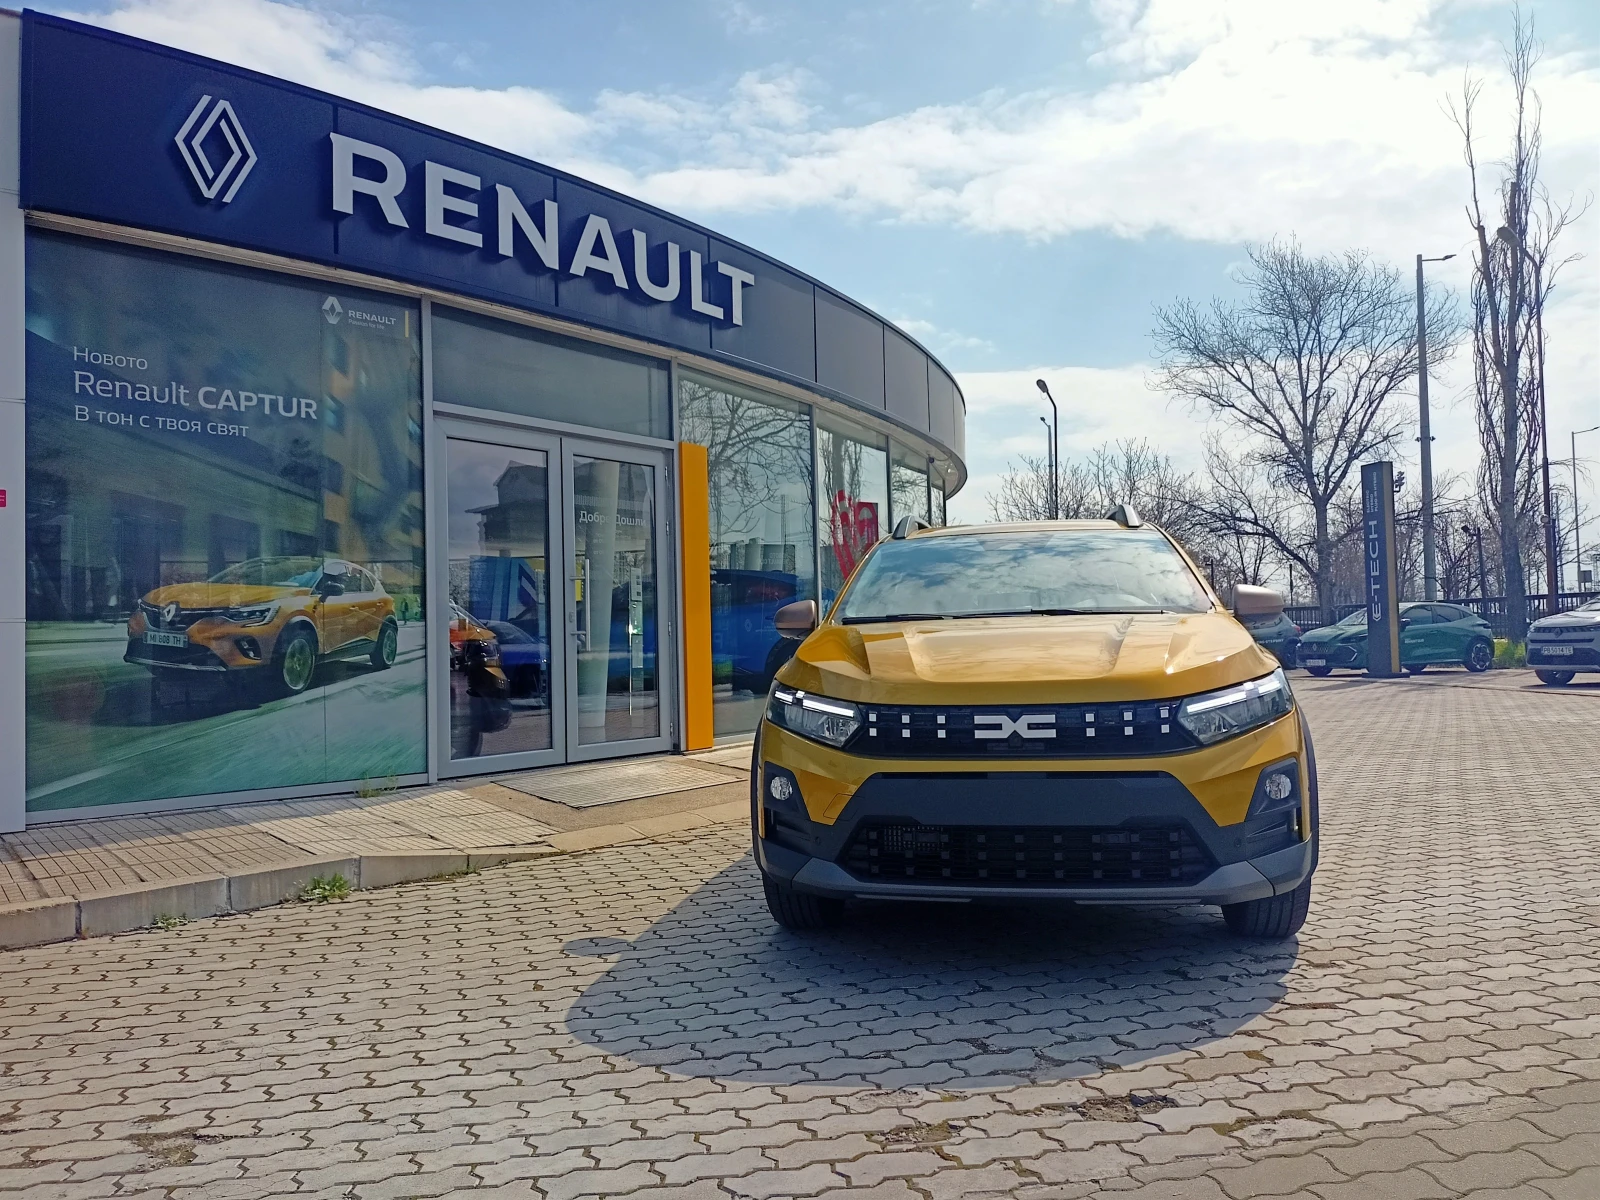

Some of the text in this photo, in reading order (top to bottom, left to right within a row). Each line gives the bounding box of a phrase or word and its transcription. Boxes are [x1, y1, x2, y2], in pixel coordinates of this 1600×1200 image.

[330, 132, 754, 326] RENAULT
[348, 310, 397, 325] RENAULT
[73, 346, 148, 370] Новото
[74, 370, 318, 420] Renault CAPTUR
[74, 405, 249, 438] В тон с твоя свят
[1368, 520, 1381, 622] E-TECH
[172, 635, 181, 645] TH
